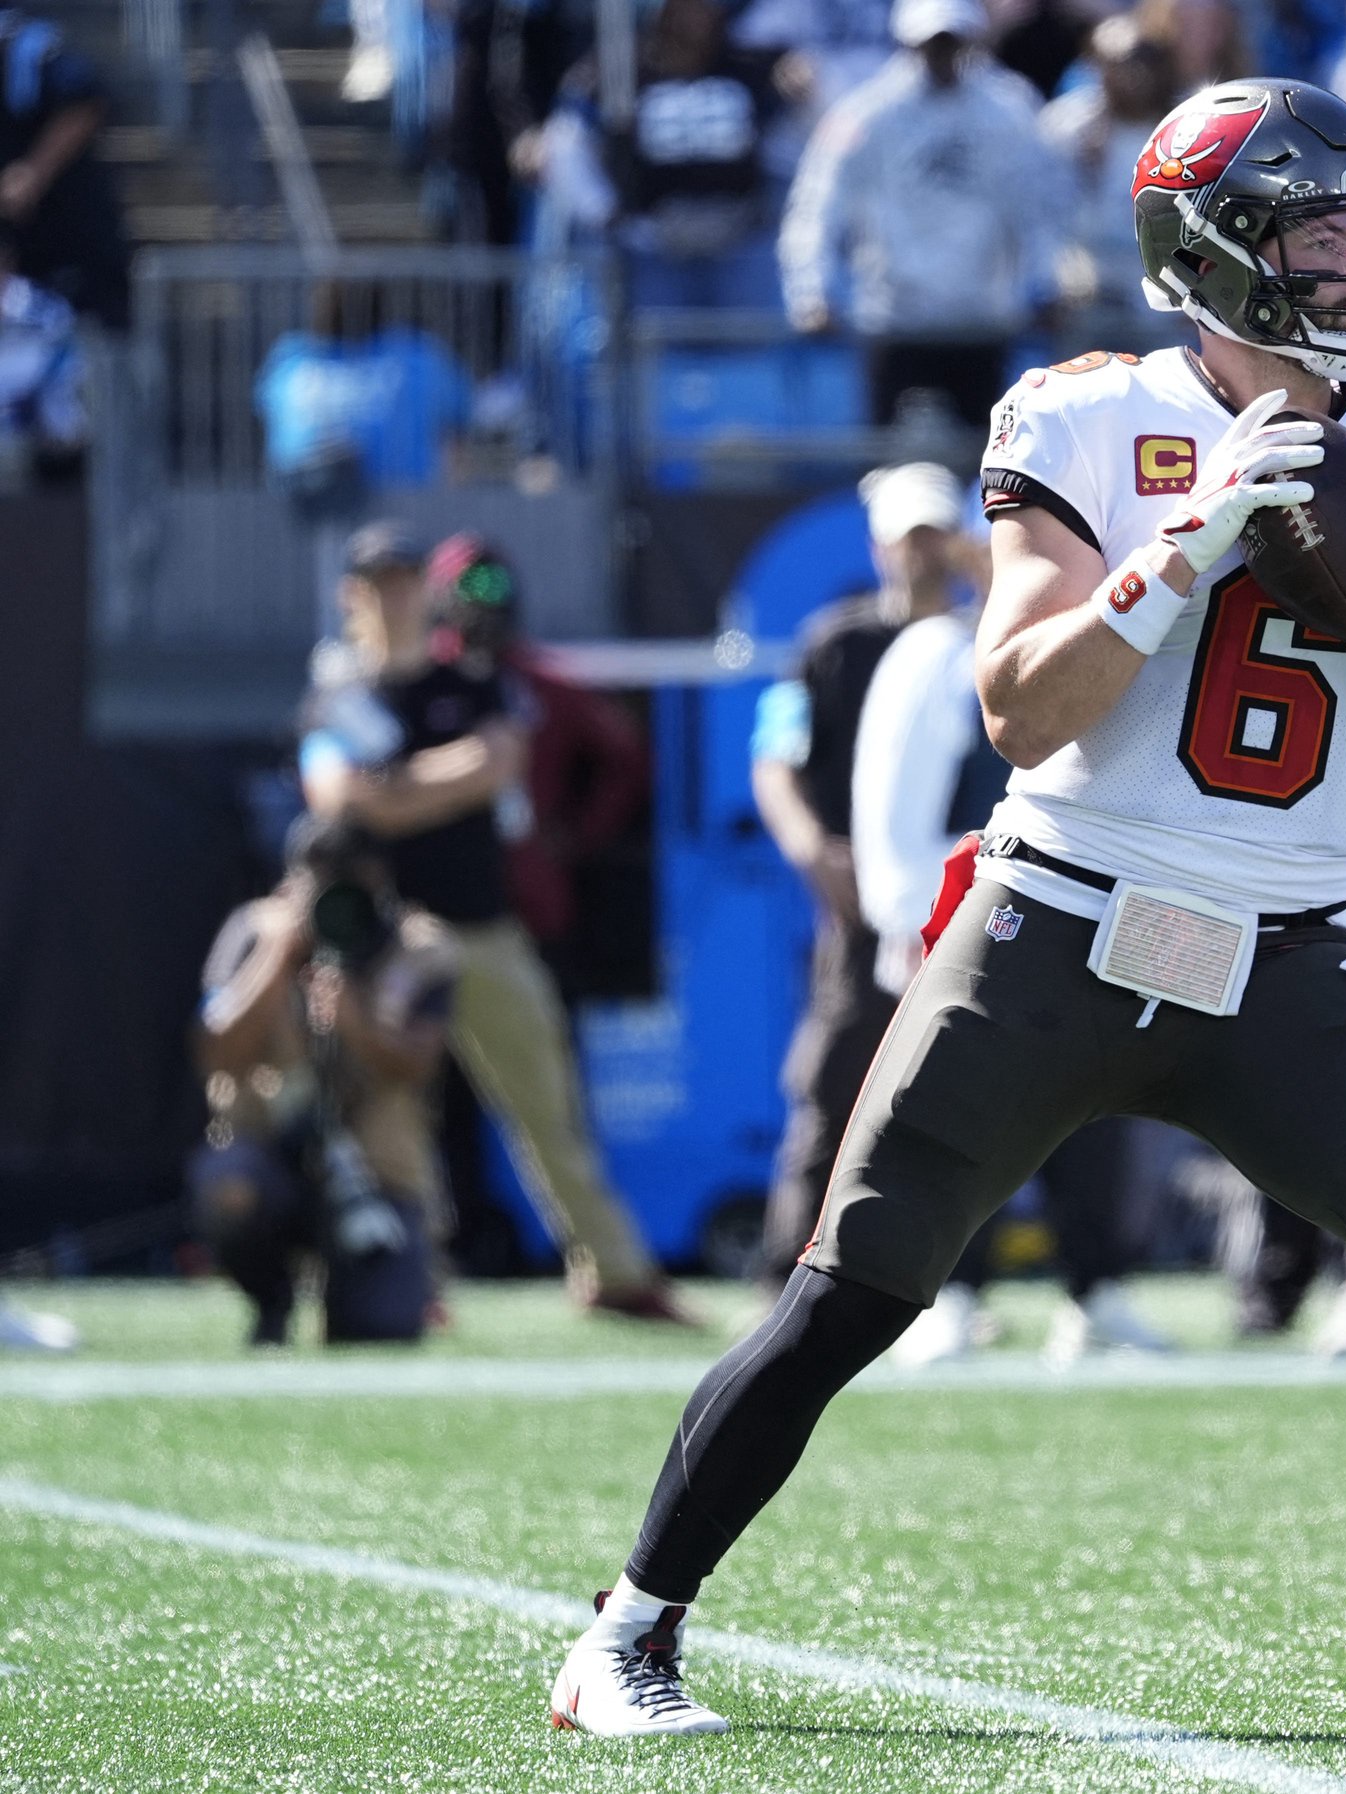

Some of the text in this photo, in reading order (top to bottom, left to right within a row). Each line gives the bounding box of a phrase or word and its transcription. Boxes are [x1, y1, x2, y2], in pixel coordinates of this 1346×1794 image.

[1282, 189, 1323, 201] OAKLEY
[1140, 439, 1192, 479] C
[1108, 570, 1147, 614] 9
[993, 919, 1014, 936] NFL
